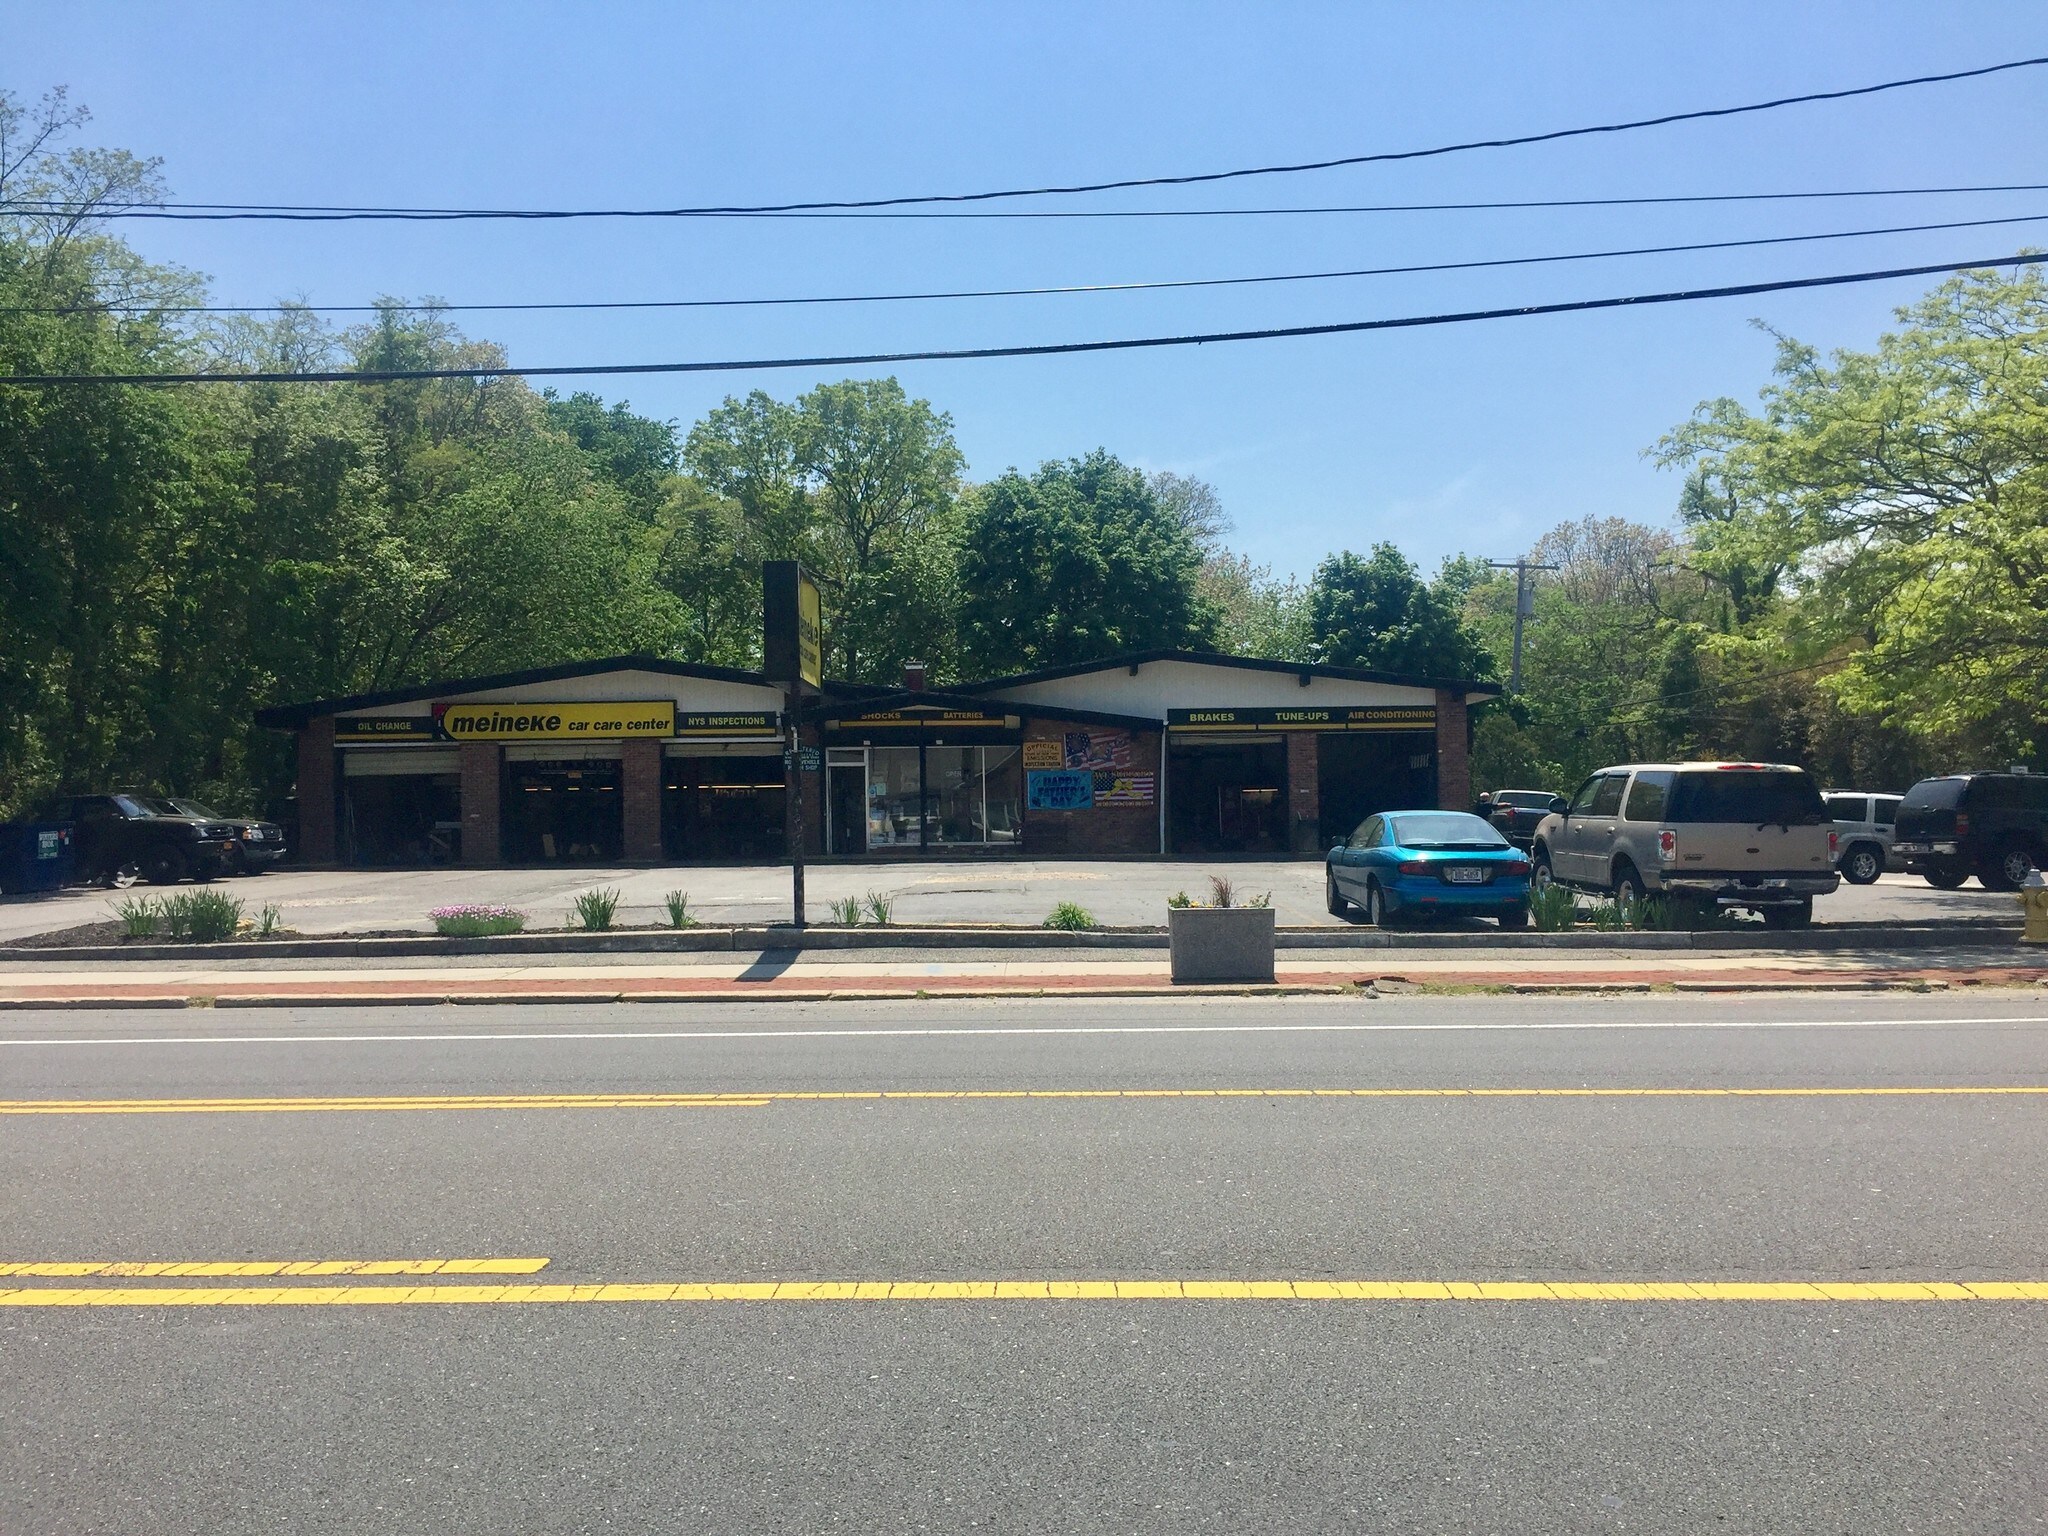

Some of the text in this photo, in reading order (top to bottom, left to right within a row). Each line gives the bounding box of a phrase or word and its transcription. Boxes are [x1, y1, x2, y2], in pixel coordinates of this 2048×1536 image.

[861, 712, 901, 720] SHOCKS
[1189, 713, 1235, 722] BRAKES
[1275, 712, 1329, 721] TUNE-UPS
[1348, 710, 1436, 719] AIR CONDITIONING
[452, 712, 670, 733] meineke car care center
[688, 716, 766, 726] NYS INSPECTIONS
[357, 722, 412, 731] OIL CHANGE
[1026, 743, 1059, 752] OFFICIAL
[1042, 775, 1080, 786] HAPPY
[1036, 786, 1086, 798] FATHER'S
[1050, 796, 1073, 808] DAY
